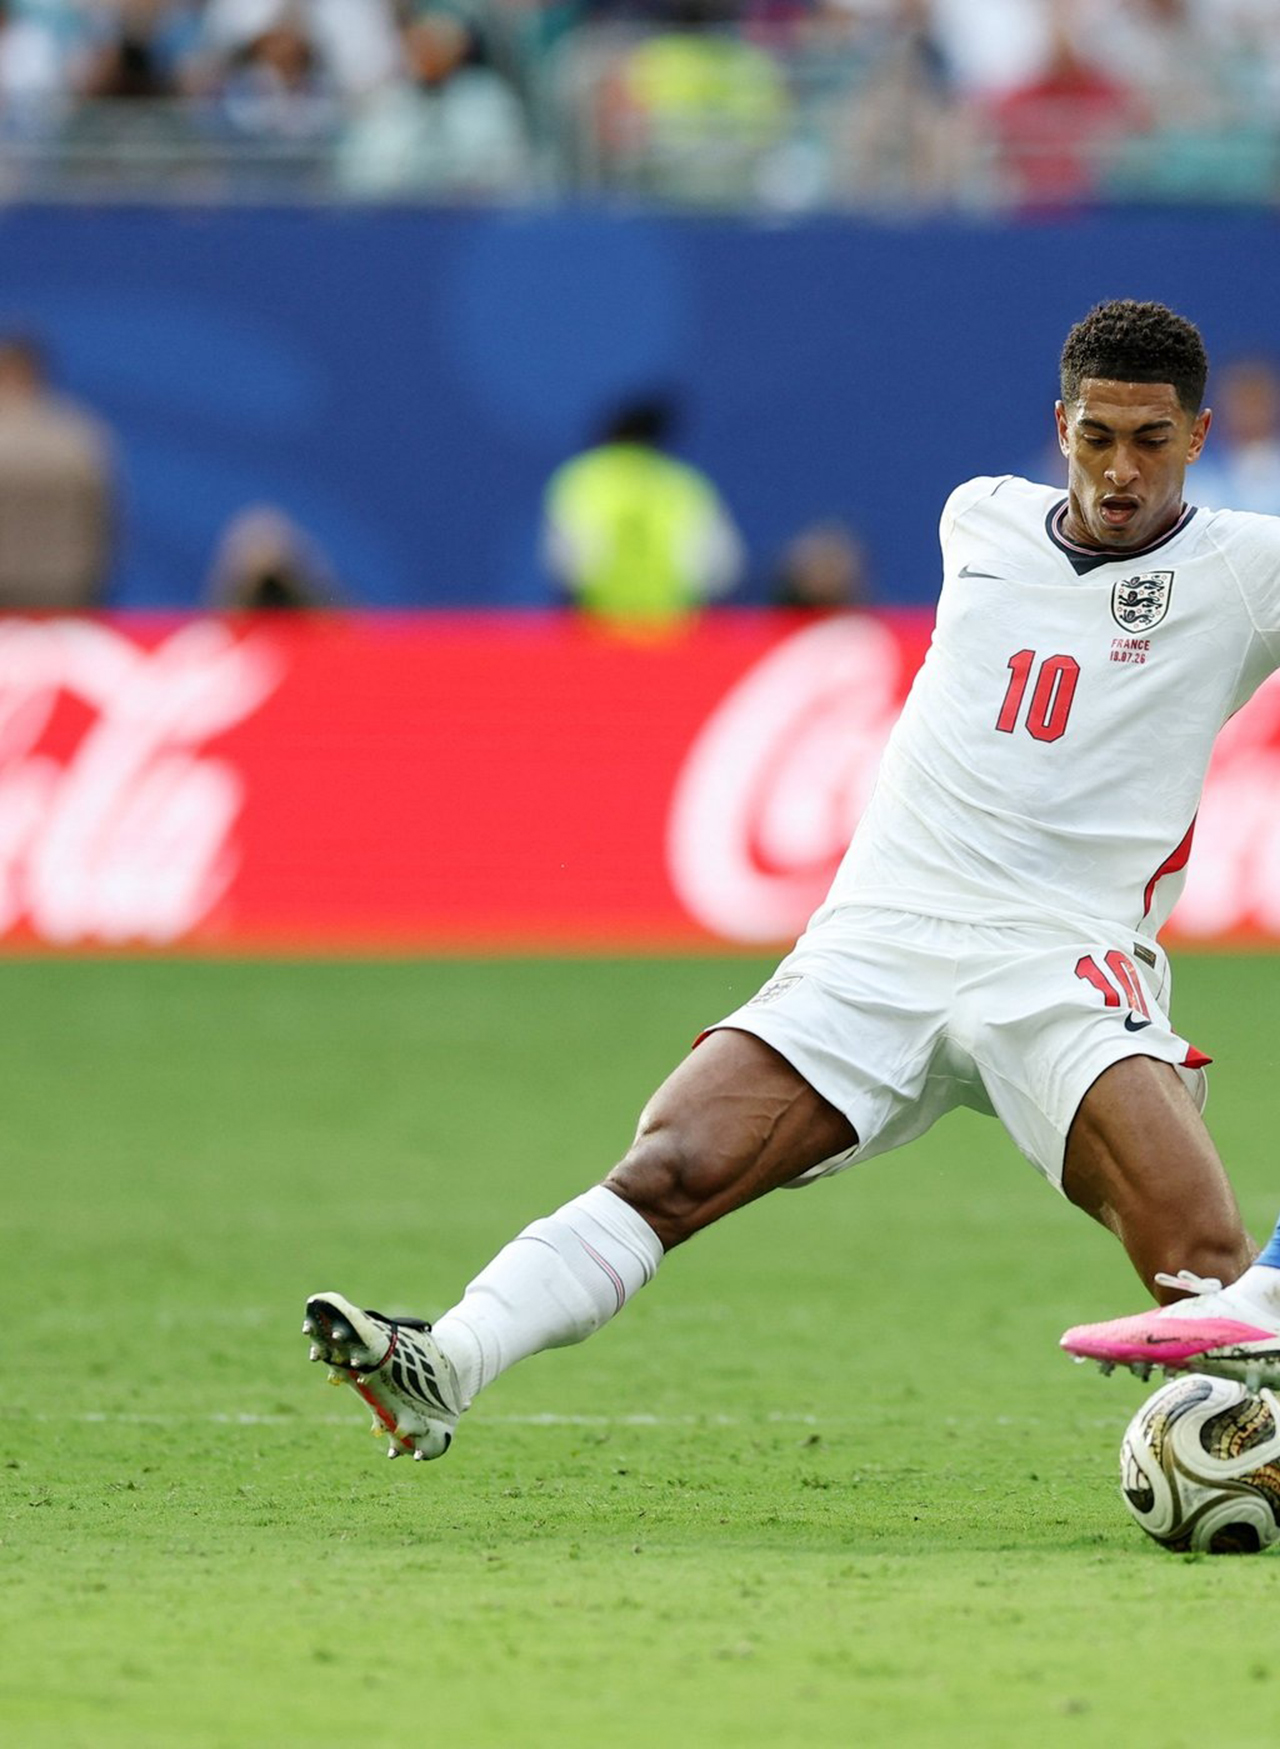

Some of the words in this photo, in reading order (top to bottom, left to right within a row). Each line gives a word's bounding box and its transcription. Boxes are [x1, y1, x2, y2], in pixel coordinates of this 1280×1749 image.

[1111, 638, 1151, 651] FRANCE
[994, 648, 1082, 744] 10
[1074, 949, 1152, 1021] 10
